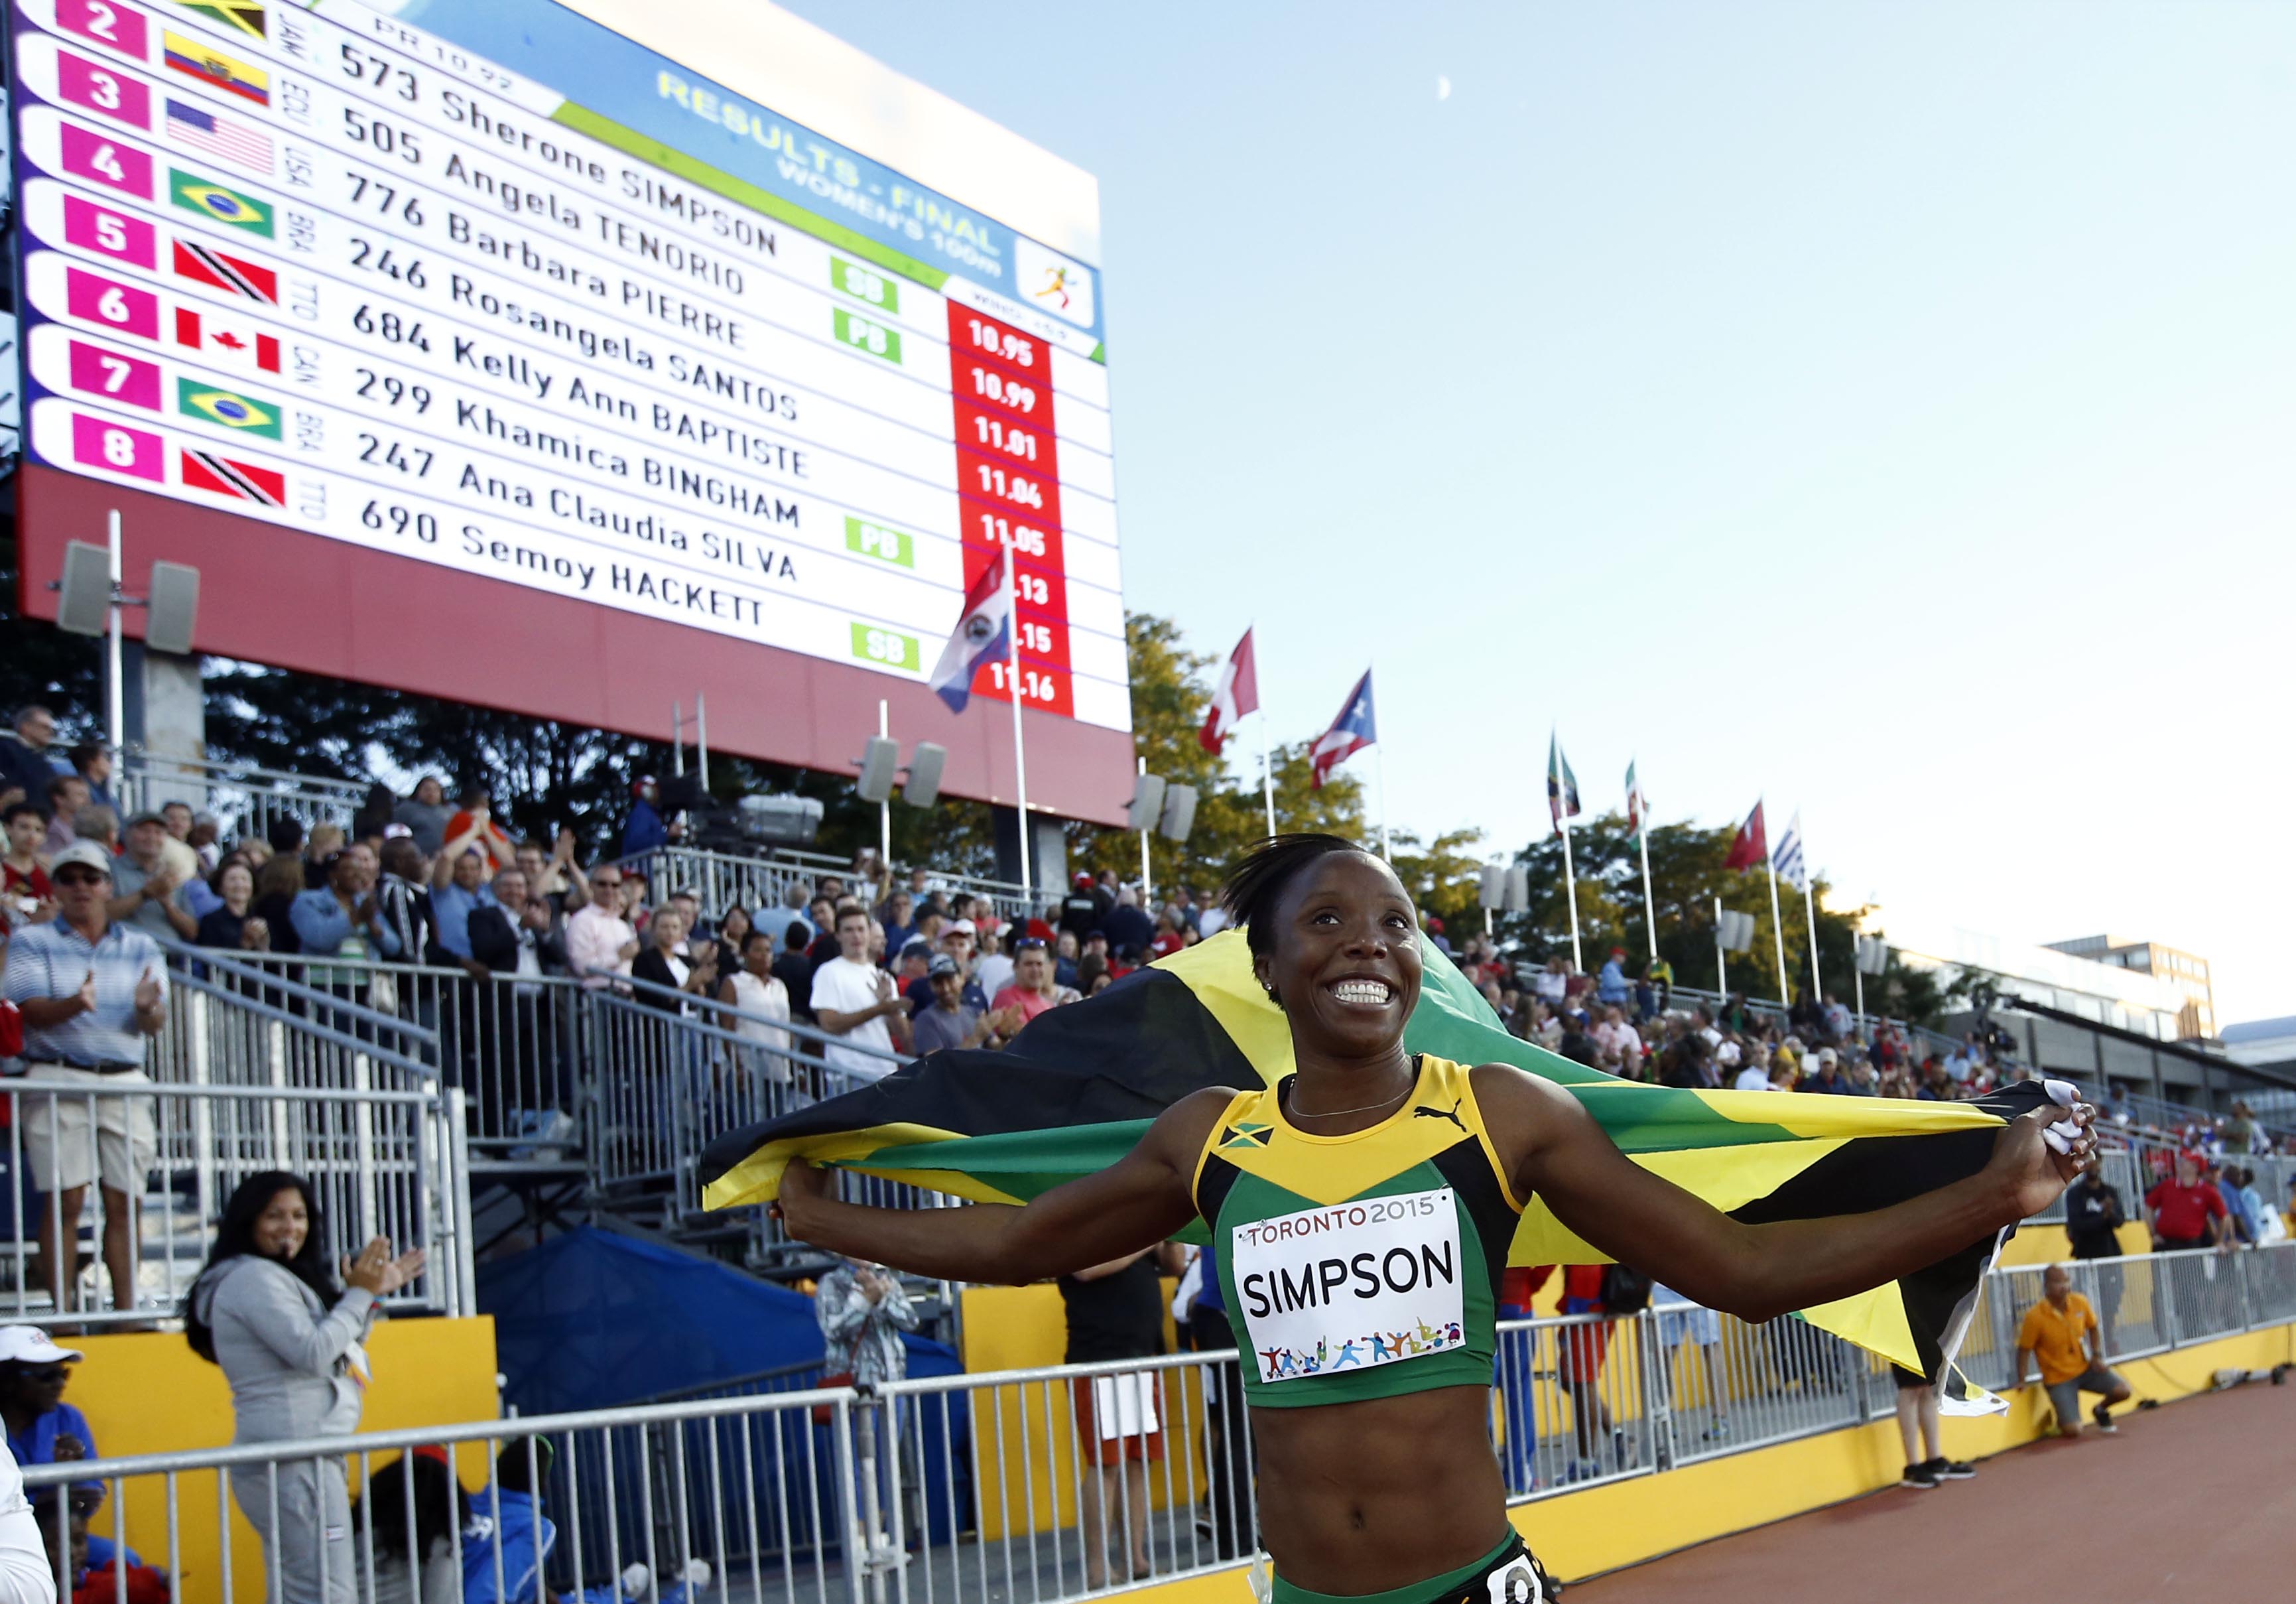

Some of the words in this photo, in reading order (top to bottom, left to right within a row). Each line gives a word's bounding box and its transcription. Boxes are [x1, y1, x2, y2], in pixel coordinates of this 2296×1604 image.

[87, 4, 118, 42] 2
[90, 73, 120, 109] 3
[281, 79, 311, 126] ECU
[92, 145, 125, 182] 4
[284, 146, 313, 188] USA
[342, 44, 417, 101] 573
[442, 90, 605, 183] Sherone
[622, 170, 775, 256] SIMPSON
[658, 70, 859, 188] RESULTS
[891, 184, 1001, 257] FINAL
[345, 107, 420, 165] 505
[446, 153, 580, 230] Angela
[596, 212, 743, 295] TENORIO
[777, 157, 924, 241] WOMEN'S
[930, 231, 1002, 277] 100m
[96, 213, 126, 251] 5
[287, 210, 316, 253] BRA
[345, 172, 424, 227] 776
[448, 212, 606, 297] Barbara
[622, 279, 745, 349] PIERRE
[99, 287, 129, 323] 6
[846, 267, 883, 302] SB
[350, 238, 426, 290] 246
[451, 274, 654, 371] Rosangela
[669, 355, 797, 421] SANTOS
[849, 317, 886, 354] PB
[968, 319, 1033, 367] 10.95
[101, 356, 131, 393] 7
[353, 303, 430, 353] 684
[455, 335, 552, 398] Kelly
[568, 377, 637, 423] Ann
[654, 402, 808, 478] BAPTISTE
[972, 368, 1035, 413] 10.99
[103, 429, 135, 466] 8
[295, 410, 324, 452] BRA
[355, 367, 430, 415] 299
[457, 399, 627, 478] Khamica
[645, 458, 798, 529] BINGHAM
[974, 416, 1037, 461] 11.01
[358, 433, 433, 478] 247
[460, 464, 534, 508] Ana
[550, 489, 687, 551] Claudia
[702, 533, 797, 582] SILVA
[978, 465, 1043, 509] 11.04
[861, 525, 899, 559] PB
[981, 514, 1045, 557] 11.05
[361, 500, 437, 544] 690
[462, 525, 594, 590] Semoy
[612, 565, 765, 627] HACKETT
[1013, 574, 1049, 605] .13
[865, 629, 905, 663] SB
[1015, 622, 1051, 653] .15
[990, 662, 1054, 702] 11.16
[1243, 1240, 1454, 1319] SIMPSON
